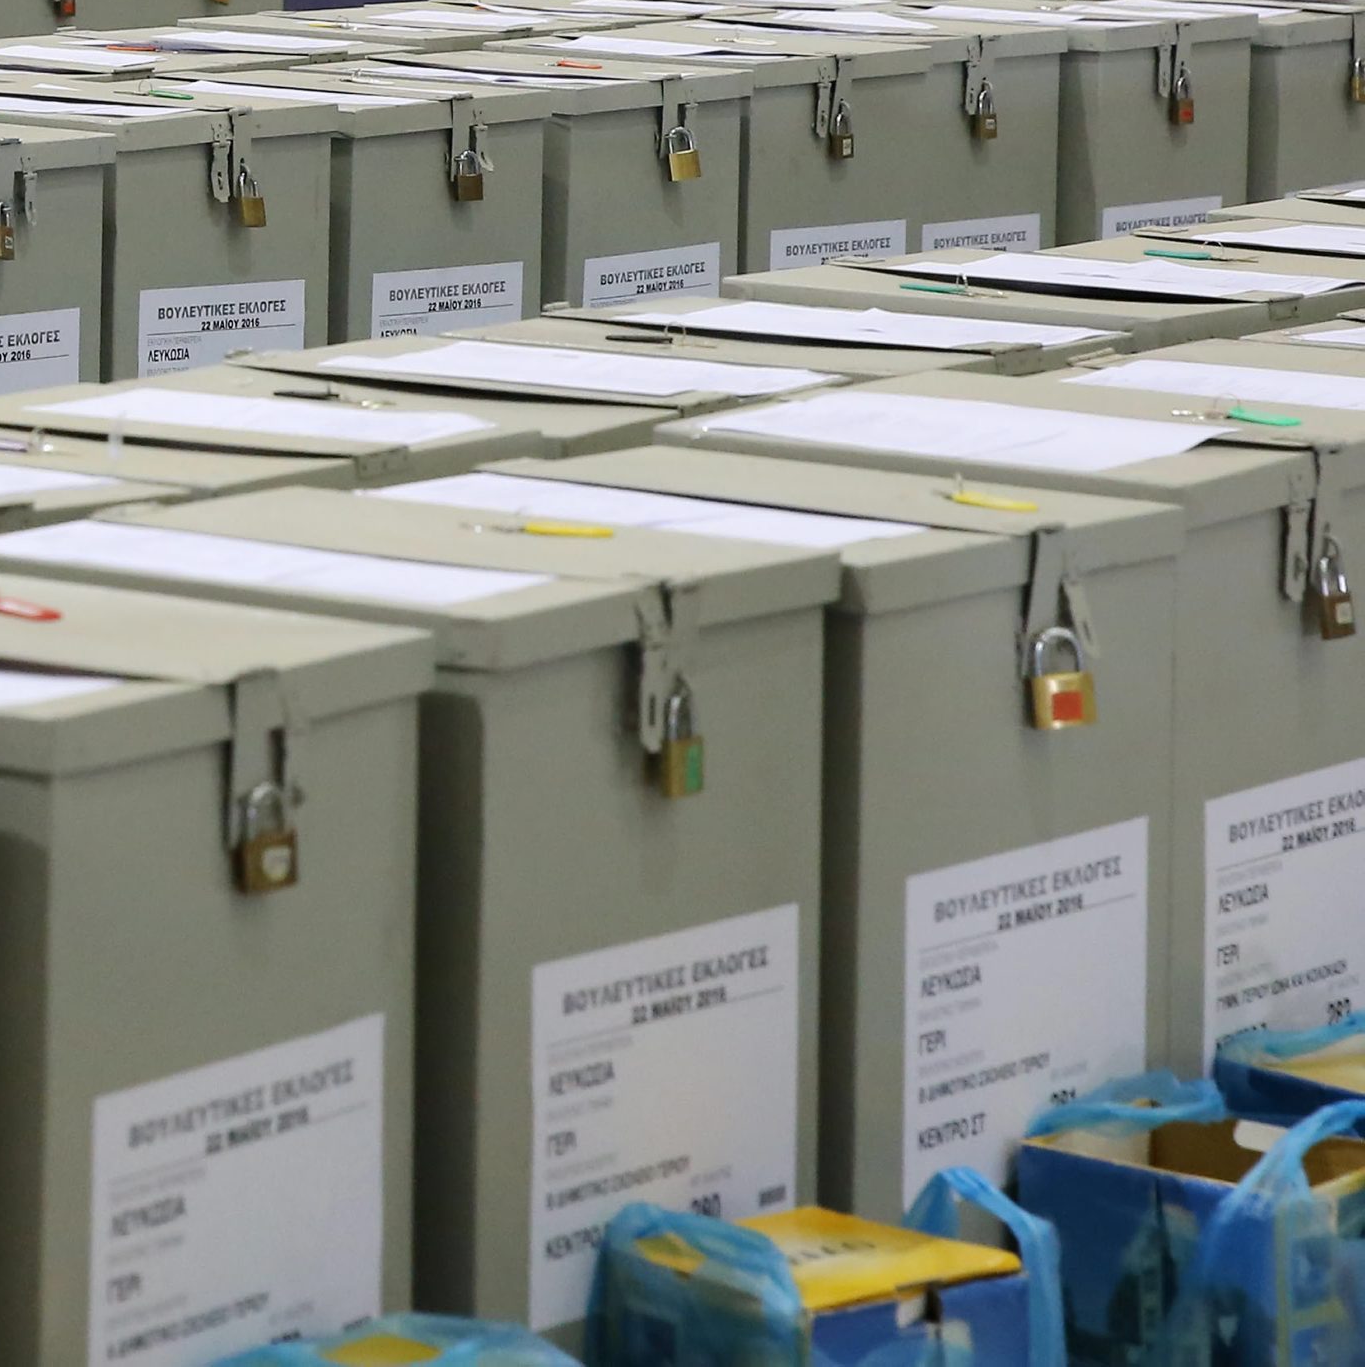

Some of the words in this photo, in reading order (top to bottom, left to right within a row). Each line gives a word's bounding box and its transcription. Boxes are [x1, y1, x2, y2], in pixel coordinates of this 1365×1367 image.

[786, 241, 849, 256] ΒΟΥΛΕΥΤΙΚΕΣ
[852, 237, 891, 251] ΕΚΛΟΓΕΣ
[600, 267, 664, 285] ΒΟΥΛΕΥΤΙΚΕΣ
[667, 262, 705, 276] ΕΚΛΟΓΕΣ
[389, 285, 459, 301] ΒΟΥΛΕΥΤΙΚΕΣ
[462, 281, 506, 295] ΕΚΛΟΓΕΣ
[158, 303, 235, 319] ΒΟΥΛΕΥΤΙΚΕΣ
[239, 300, 286, 314] ΕΚΛΟΓΕΣ
[428, 303, 436, 312] 22
[464, 298, 481, 309] 2016
[201, 322, 210, 331] 22
[241, 318, 260, 328] 2016
[8, 330, 60, 347] ΕΚΛΟΓΕΣ
[11, 350, 31, 361] 2016
[148, 348, 190, 362] ΛΕΥΚΩΣΙΑ
[1229, 800, 1324, 844] ΒΟΥΛΕΥΤΙΚΕΣ
[1328, 789, 1365, 816] ΕΚΛΟ
[934, 874, 1047, 923] ΒΟΥΛΕΥΤΙΚΕΣ
[1052, 856, 1122, 893] ΕΚΛΟΓΕΣ
